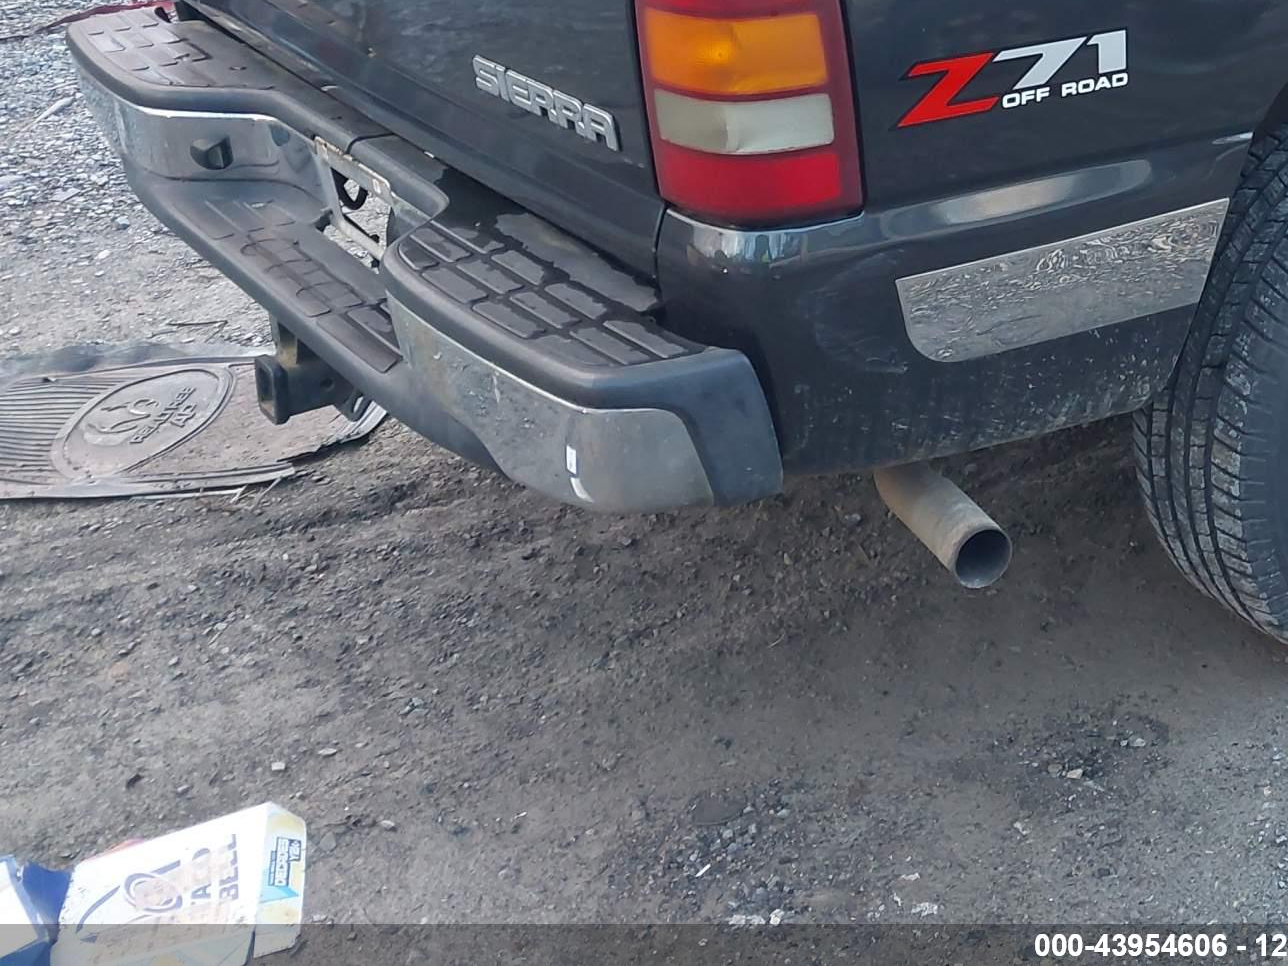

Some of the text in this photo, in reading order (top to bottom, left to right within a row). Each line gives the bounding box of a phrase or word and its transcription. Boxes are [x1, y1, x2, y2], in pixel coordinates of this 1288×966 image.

[472, 54, 619, 152] SIERRA
[896, 29, 1127, 128] Z71
[1002, 72, 1129, 109] OFF ROAD
